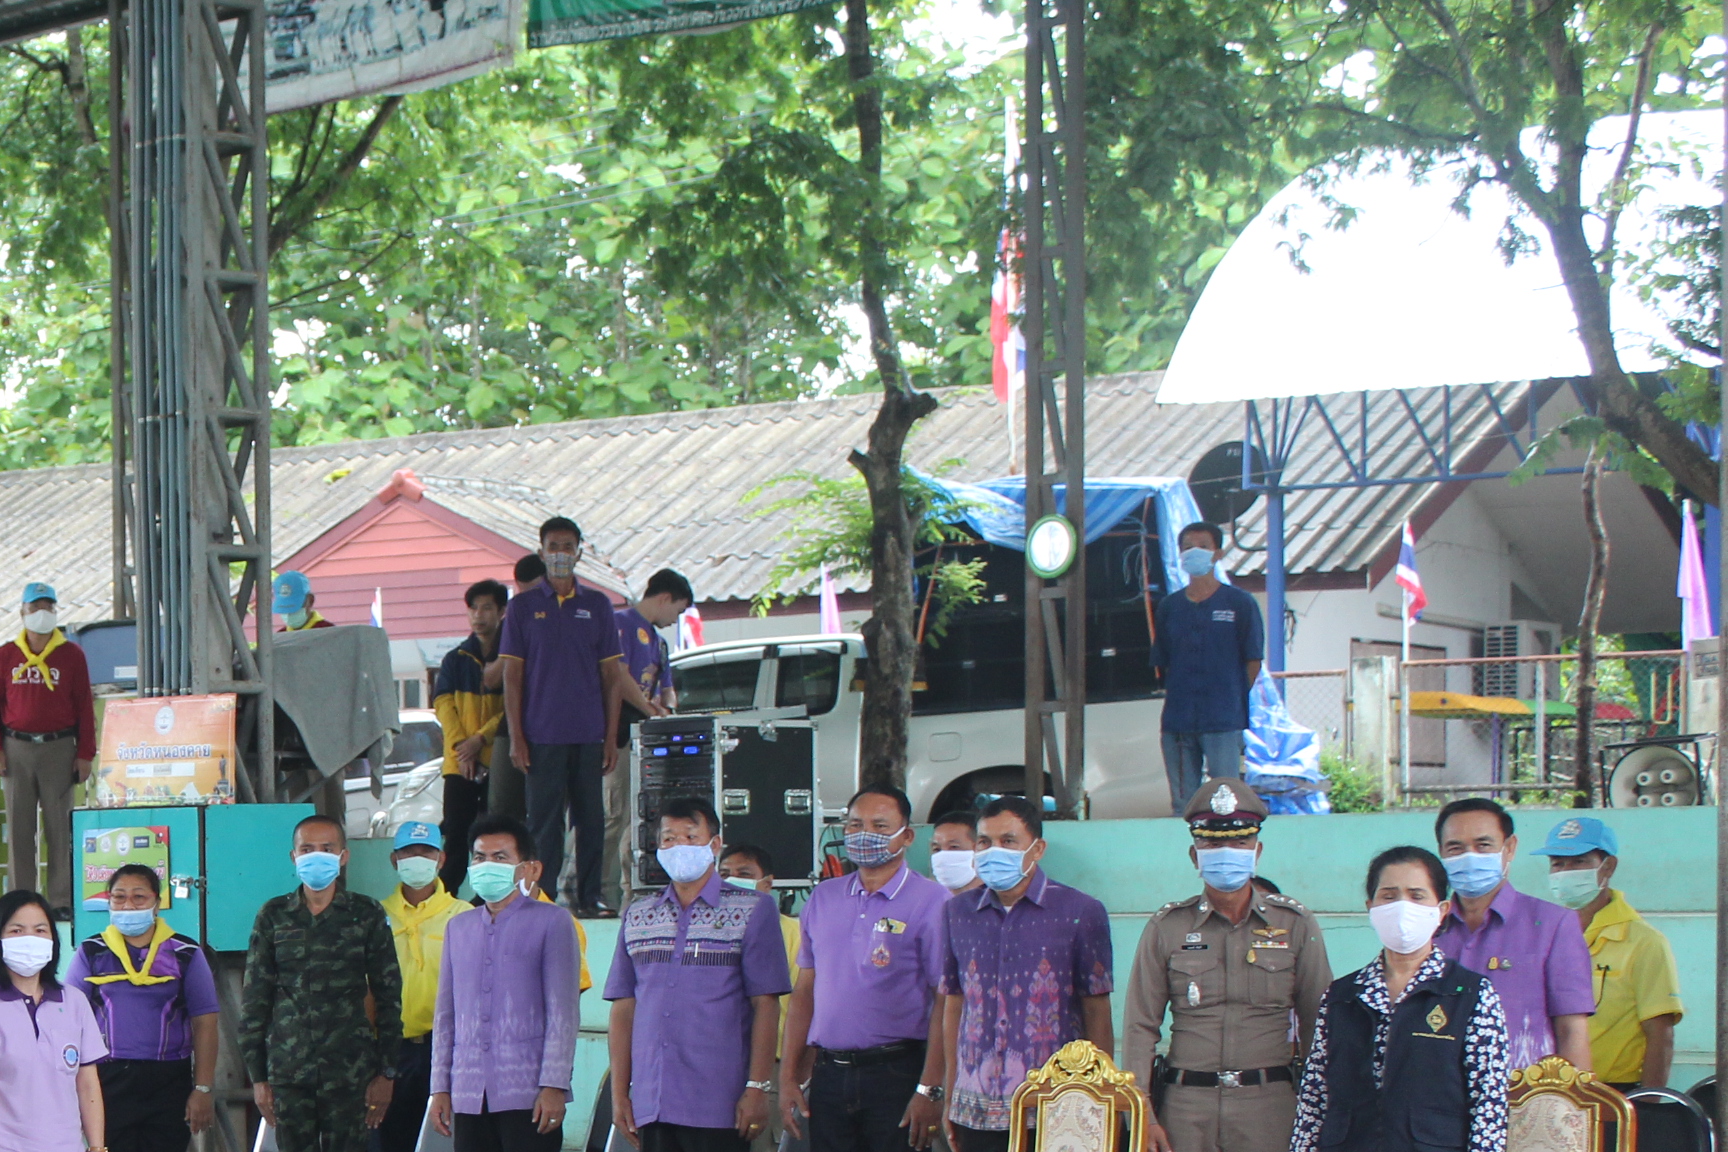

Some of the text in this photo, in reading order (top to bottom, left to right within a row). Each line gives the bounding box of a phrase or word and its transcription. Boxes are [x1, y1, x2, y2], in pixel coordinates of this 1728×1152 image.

[117, 741, 211, 760] จังหวัดหนองคาย
